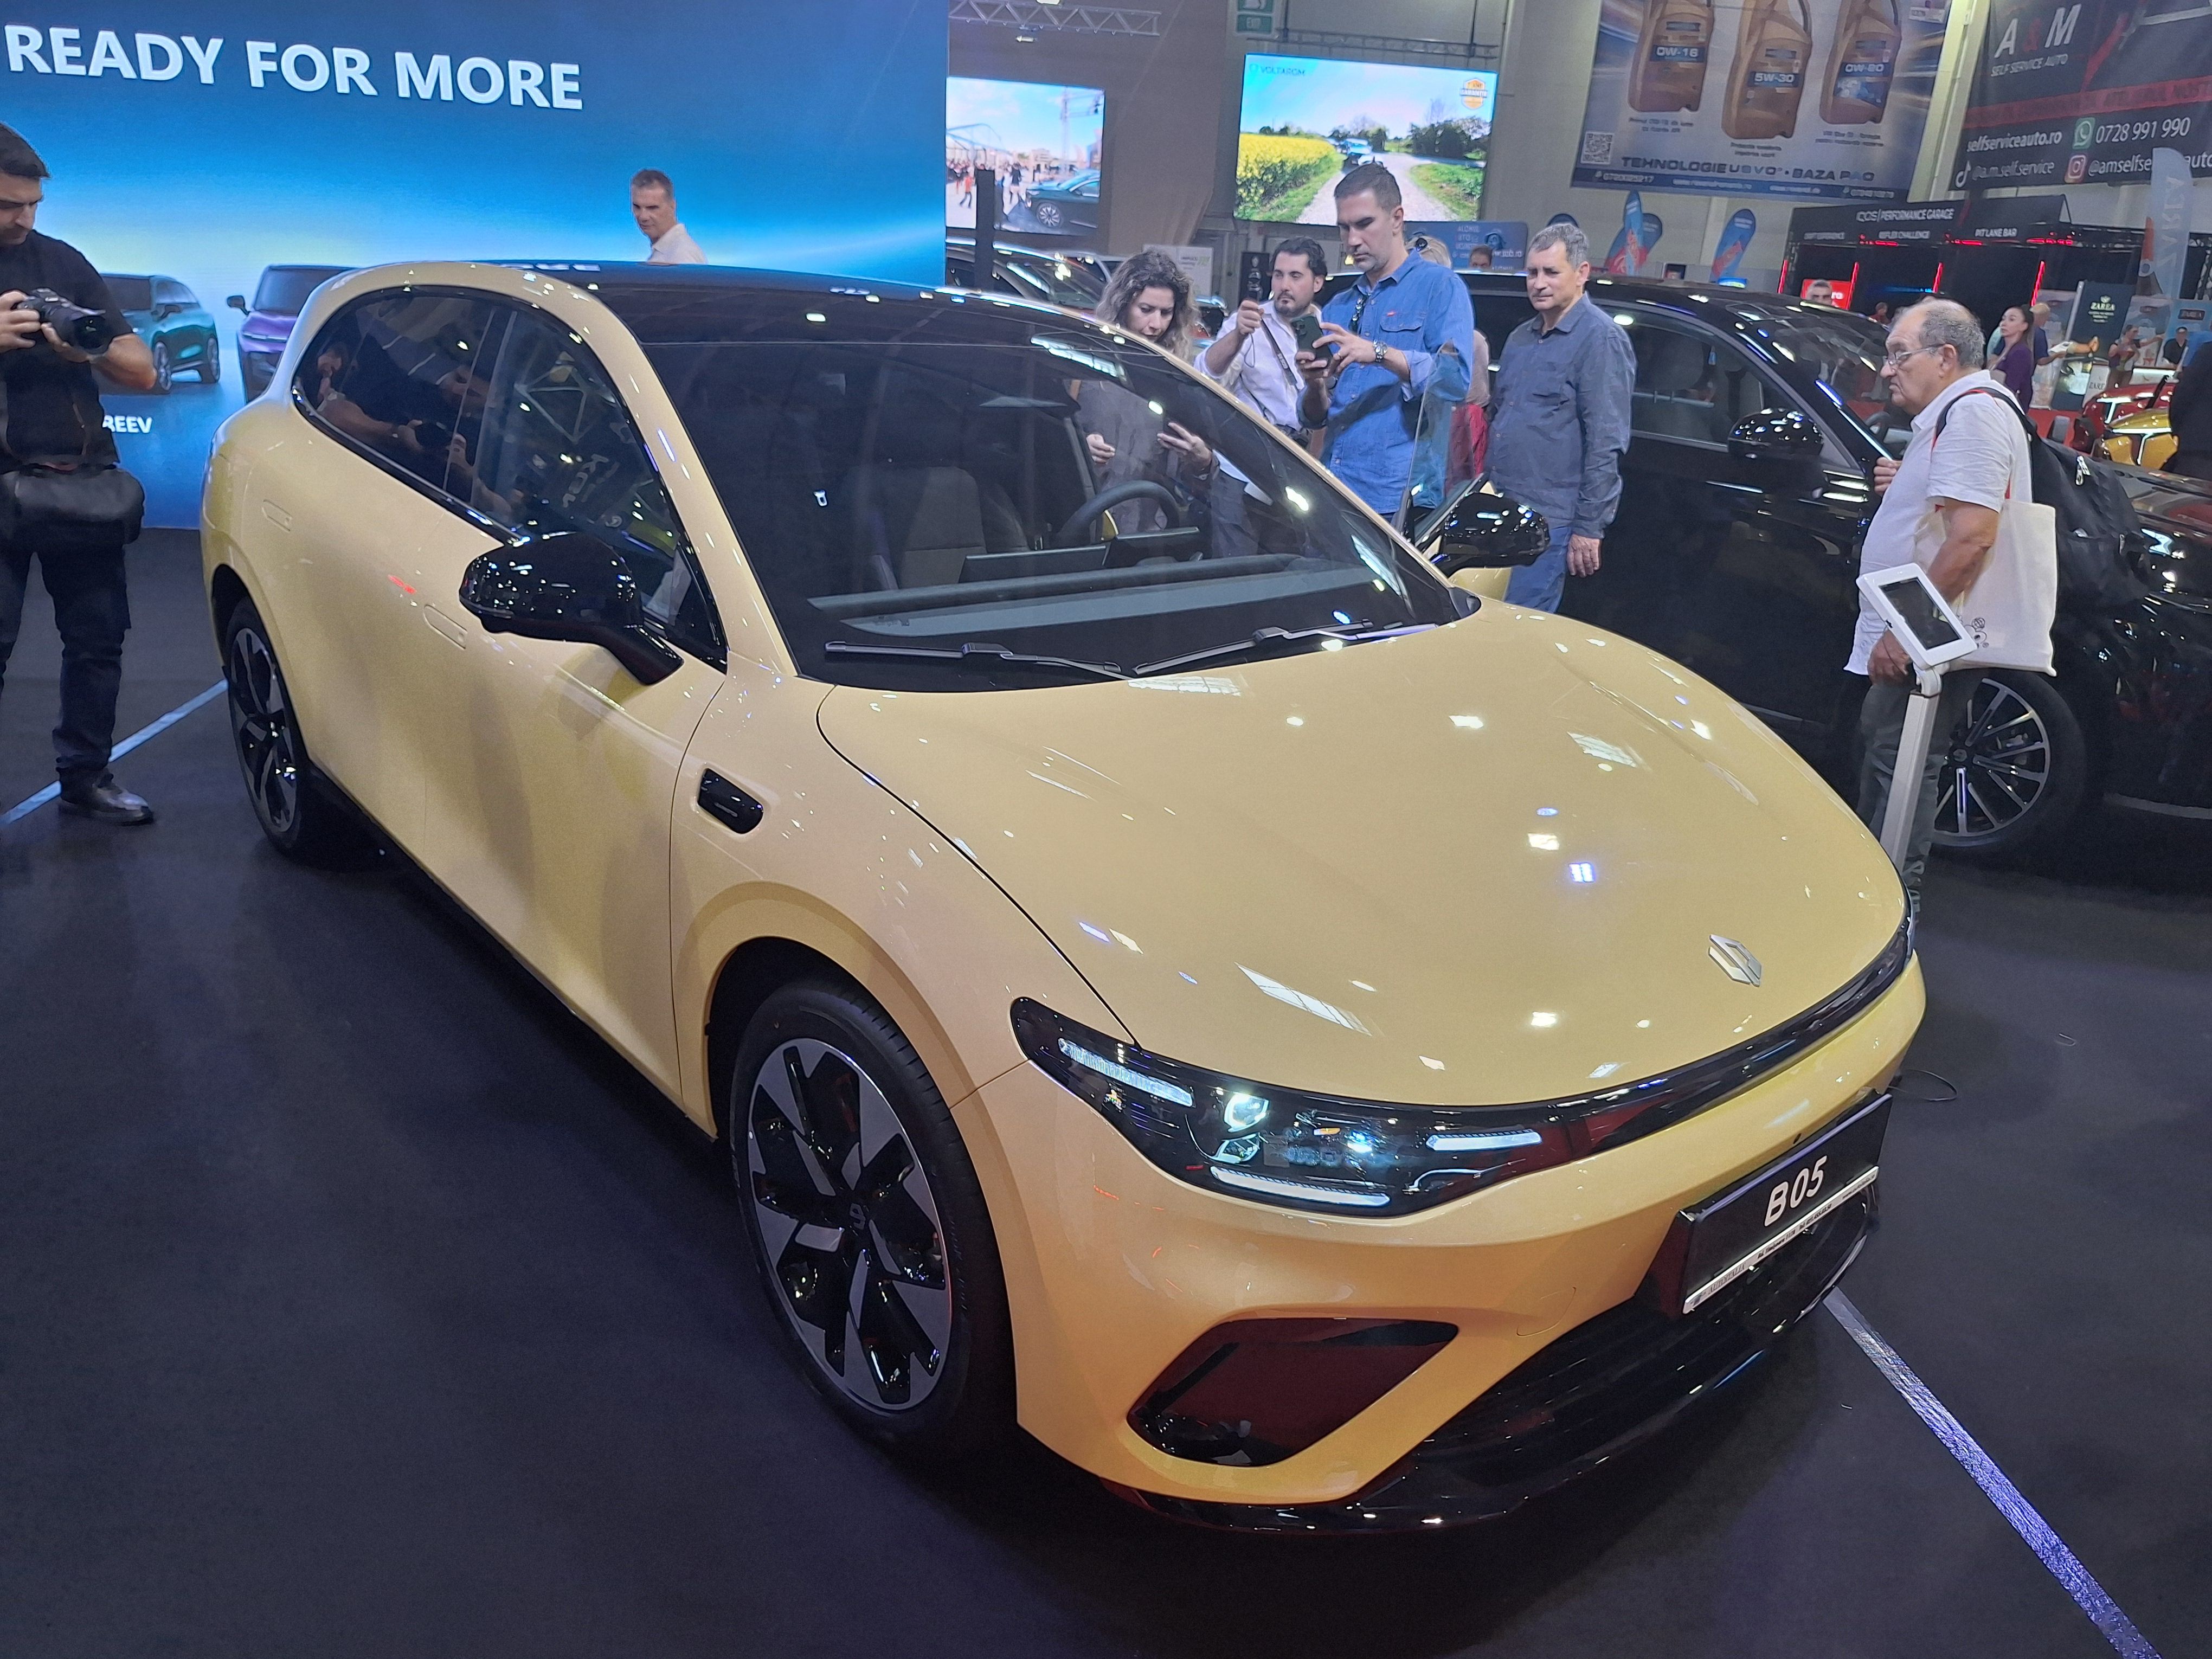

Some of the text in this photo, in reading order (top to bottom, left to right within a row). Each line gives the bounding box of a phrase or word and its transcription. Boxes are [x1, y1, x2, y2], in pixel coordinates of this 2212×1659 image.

[1994, 18, 2018, 58] A
[2044, 4, 2082, 48] M
[4, 24, 583, 111] READY FOR MORE
[1754, 73, 1795, 83] 5W-30
[1966, 117, 2191, 152] selfserviceauto.ro 0728 991 990
[2003, 228, 2017, 237] BAR
[102, 415, 152, 433] REEV
[1764, 1155, 1828, 1227] B05
